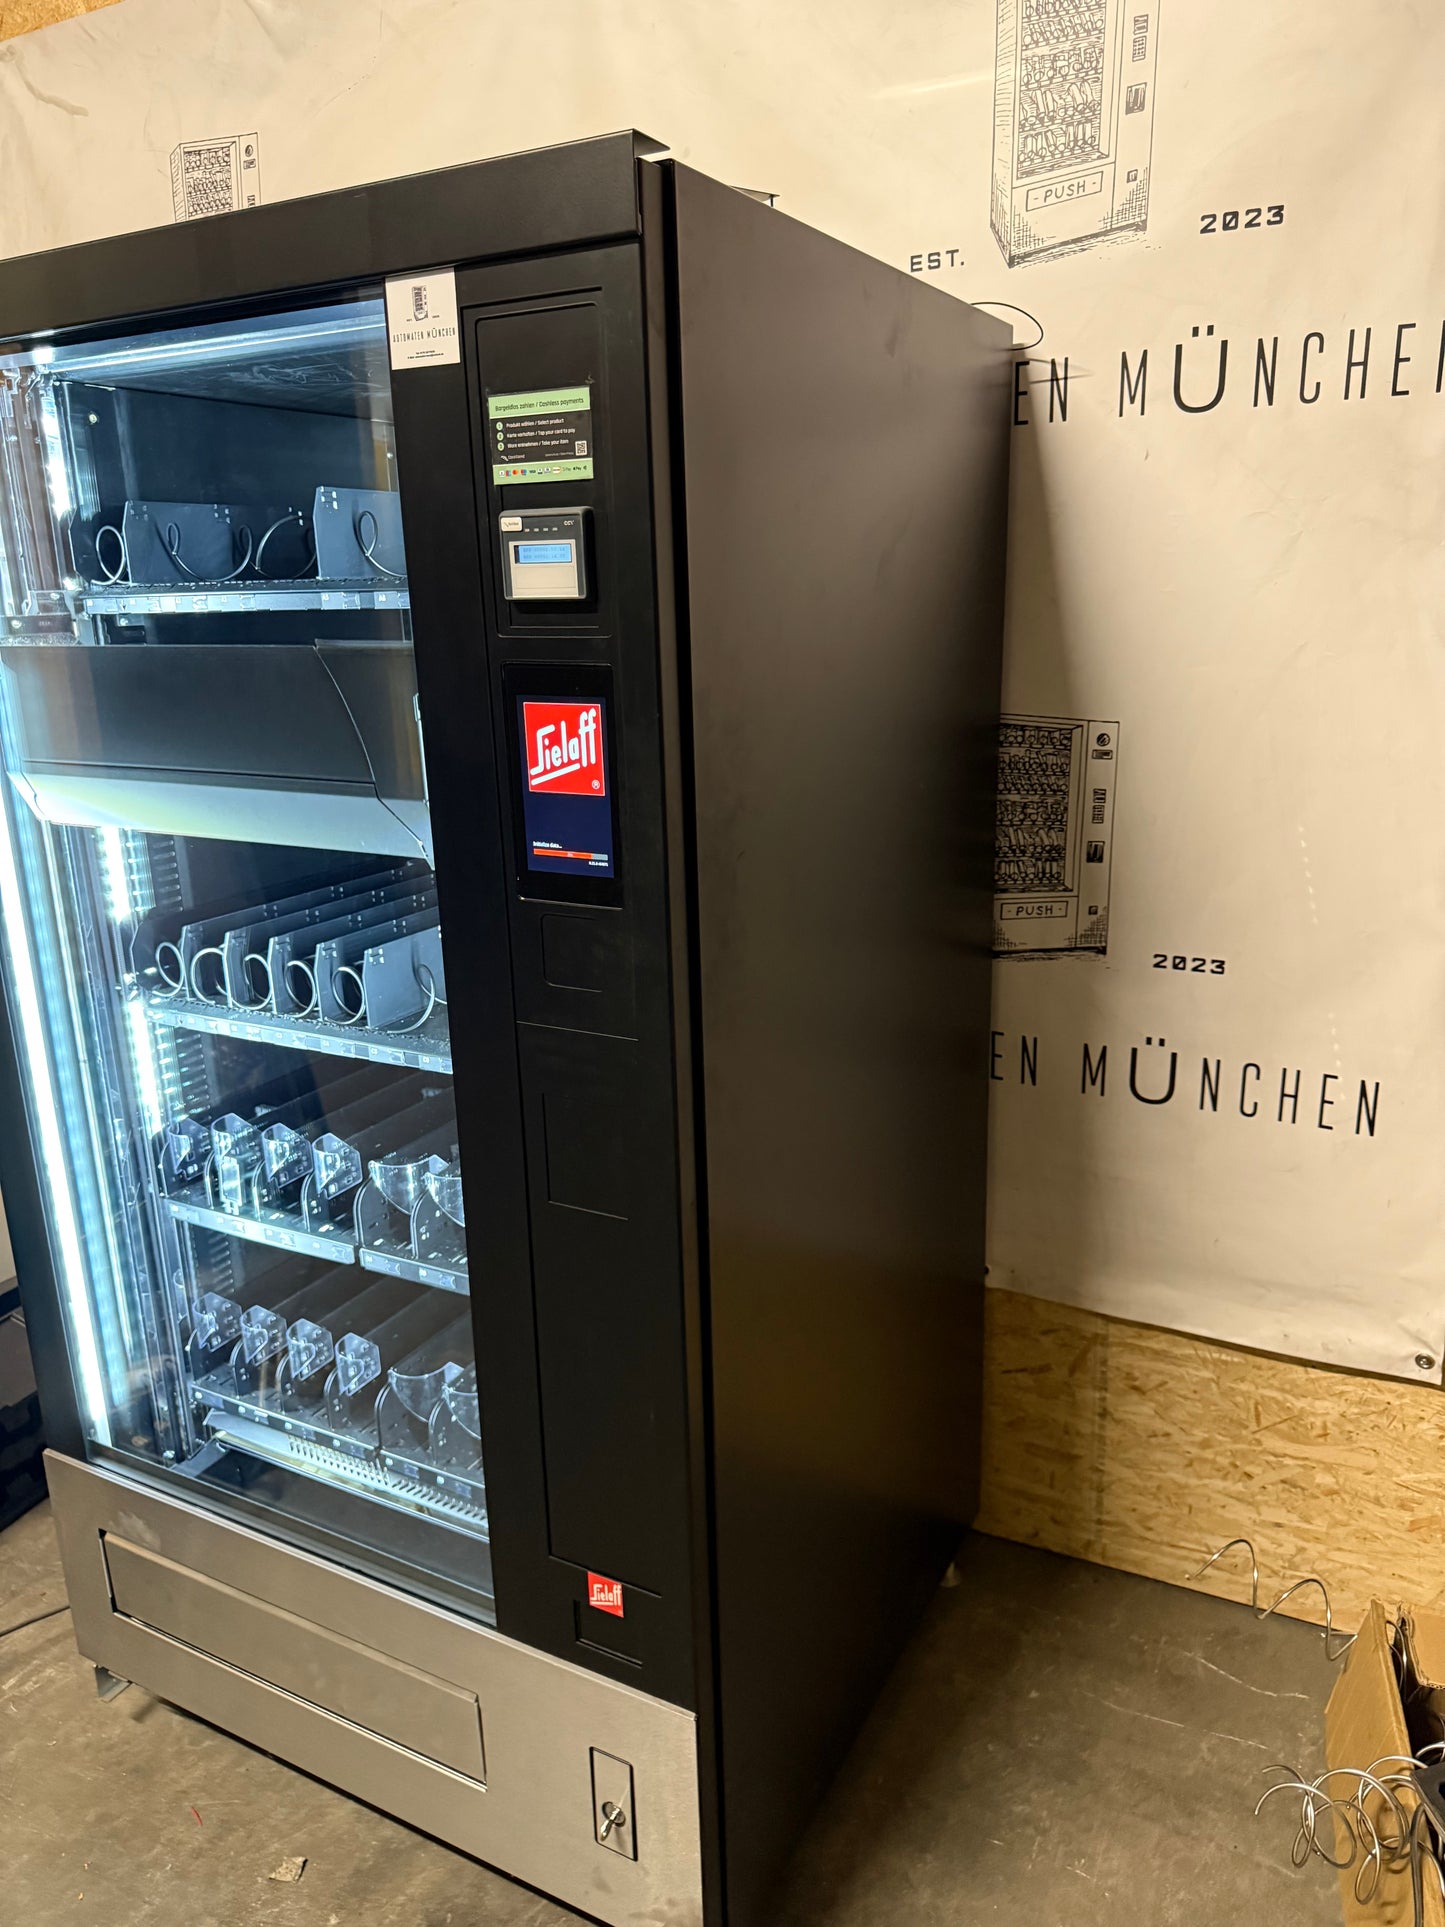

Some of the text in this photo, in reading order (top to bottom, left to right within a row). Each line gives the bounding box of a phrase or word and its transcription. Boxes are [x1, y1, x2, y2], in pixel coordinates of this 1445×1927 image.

[1043, 180, 1087, 205] PUSH
[1199, 204, 1286, 235] 2023
[909, 248, 966, 273] EST.
[427, 327, 456, 338] MÜNCHEN
[539, 399, 559, 408] Cashless
[560, 397, 584, 407] payments
[529, 708, 597, 777] Sielaff
[1015, 904, 1054, 916] PUSH
[1152, 953, 1227, 975] 2023
[1081, 1036, 1381, 1137] MÜNCHEN
[589, 1583, 622, 1606] Sielaff
